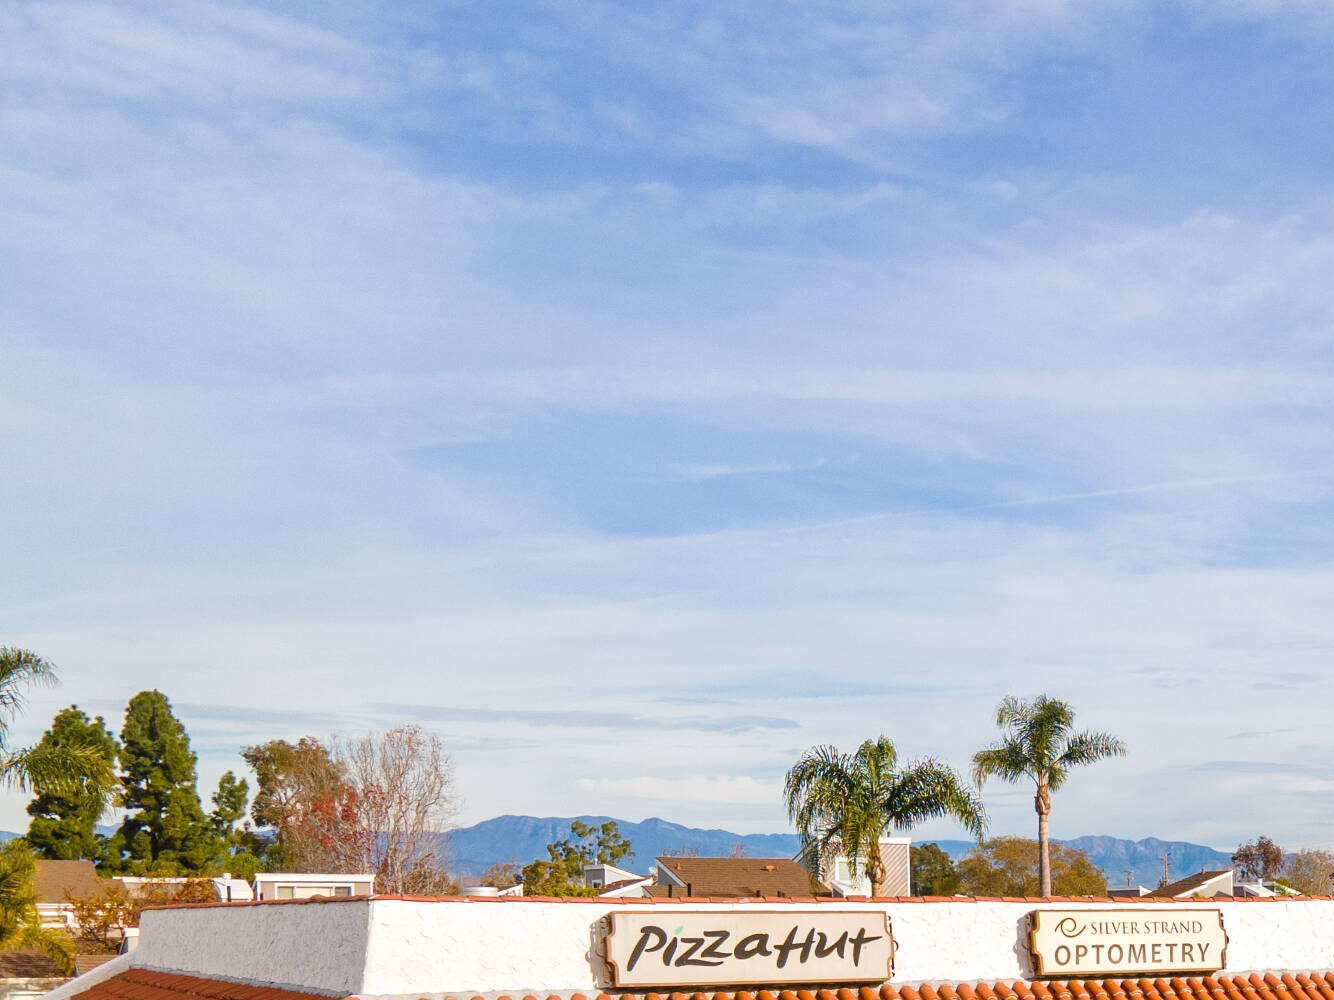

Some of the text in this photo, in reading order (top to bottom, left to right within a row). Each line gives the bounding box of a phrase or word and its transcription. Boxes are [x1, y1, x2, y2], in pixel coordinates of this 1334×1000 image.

[1091, 921, 1203, 935] SILVER STRAND
[1055, 943, 1210, 966] OPTOMETRY
